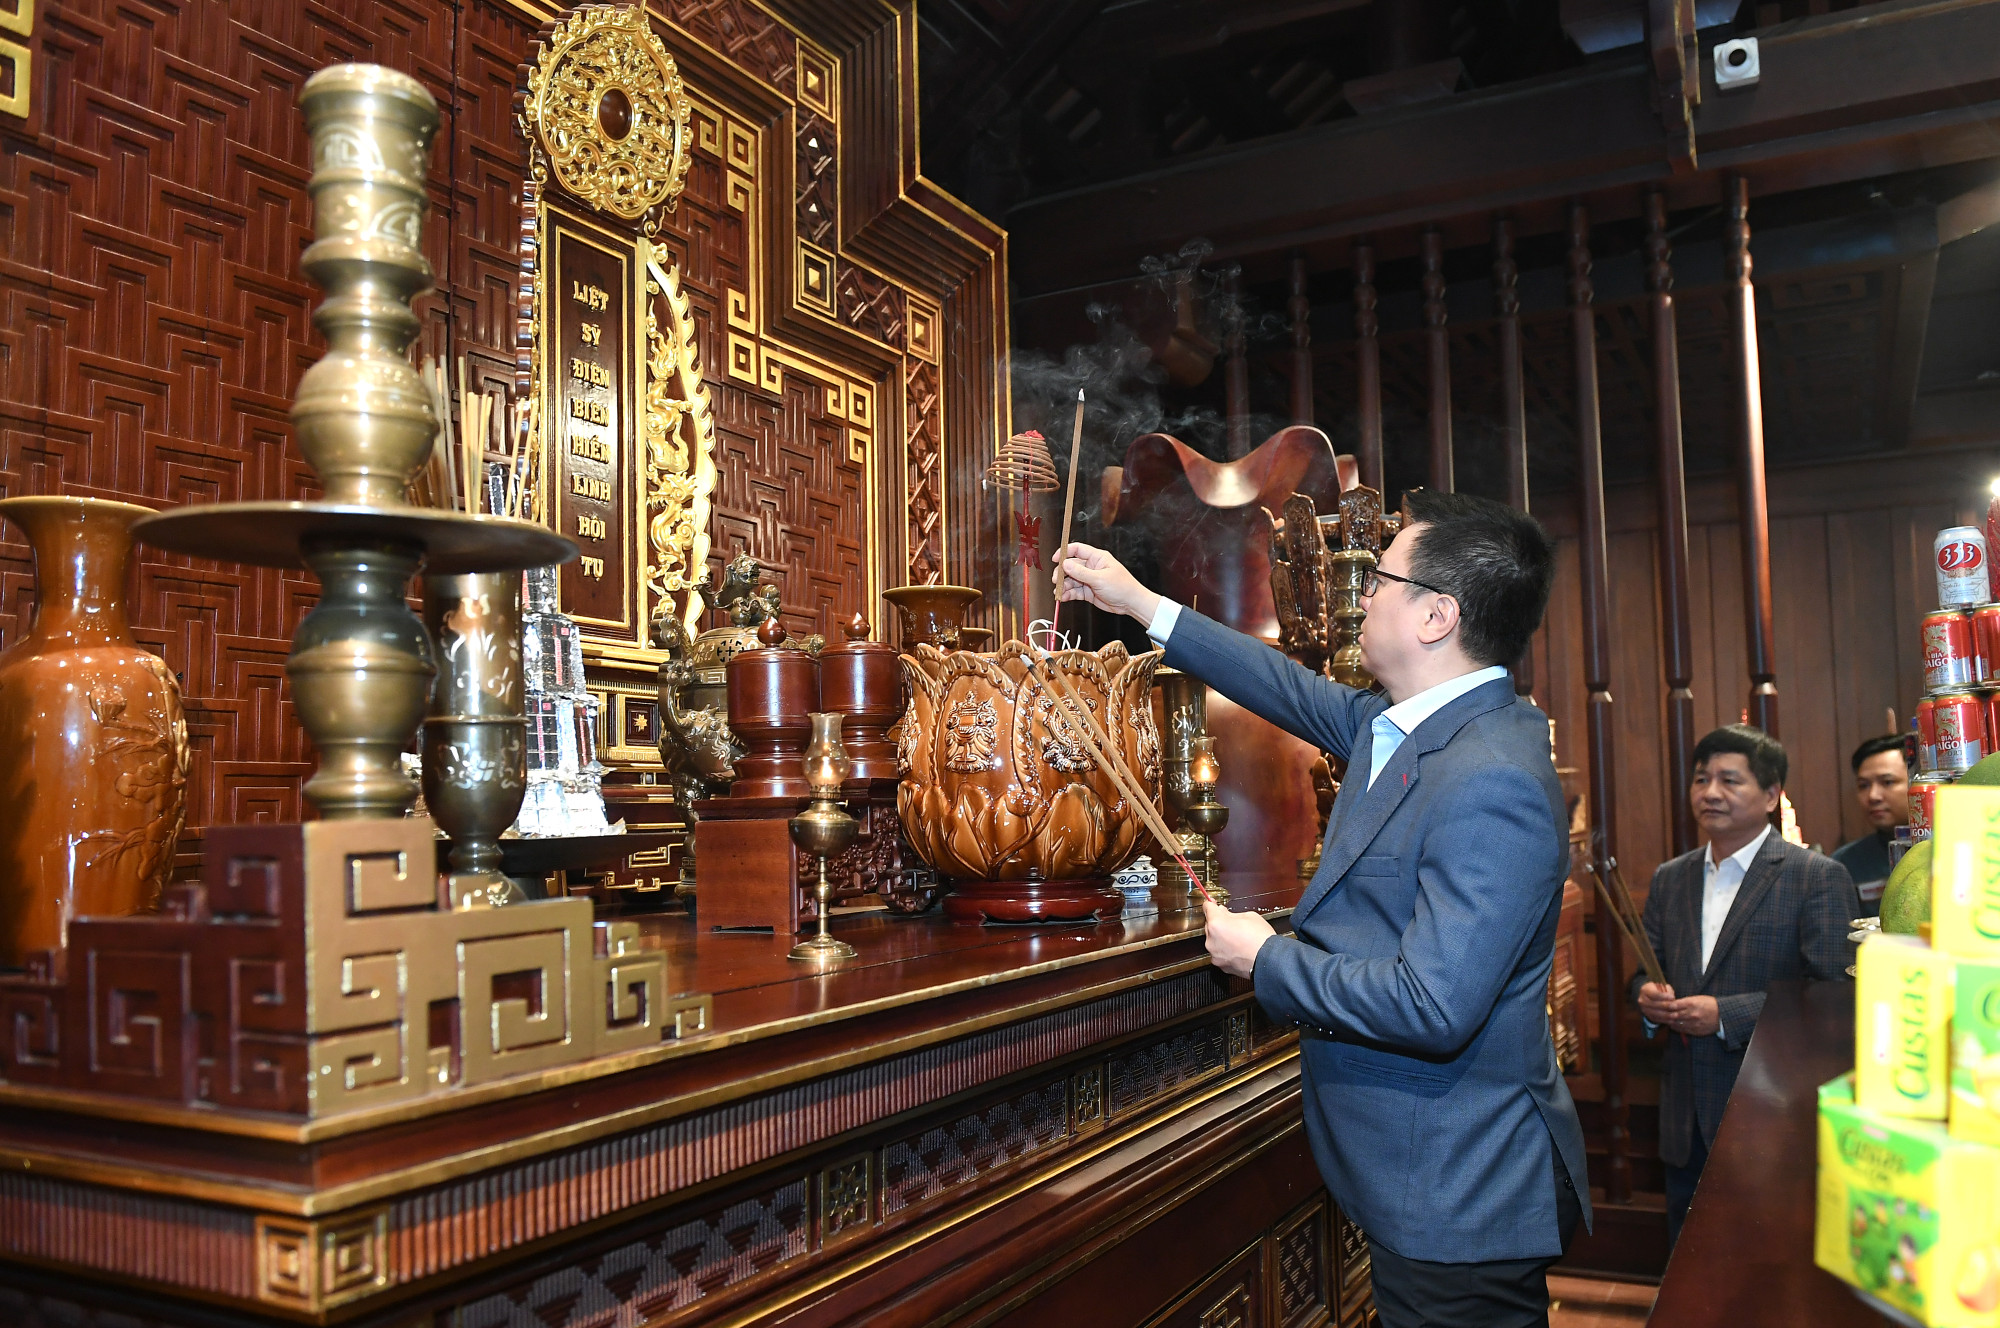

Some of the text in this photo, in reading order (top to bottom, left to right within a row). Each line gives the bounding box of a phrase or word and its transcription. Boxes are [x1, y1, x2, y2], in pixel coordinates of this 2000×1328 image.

[573, 280, 609, 310] LIỆT
[572, 398, 610, 427] BIÊN
[572, 474, 611, 502] LINH
[578, 514, 606, 542] HỘI
[580, 555, 604, 582] TỤ
[1942, 540, 1974, 569] 333
